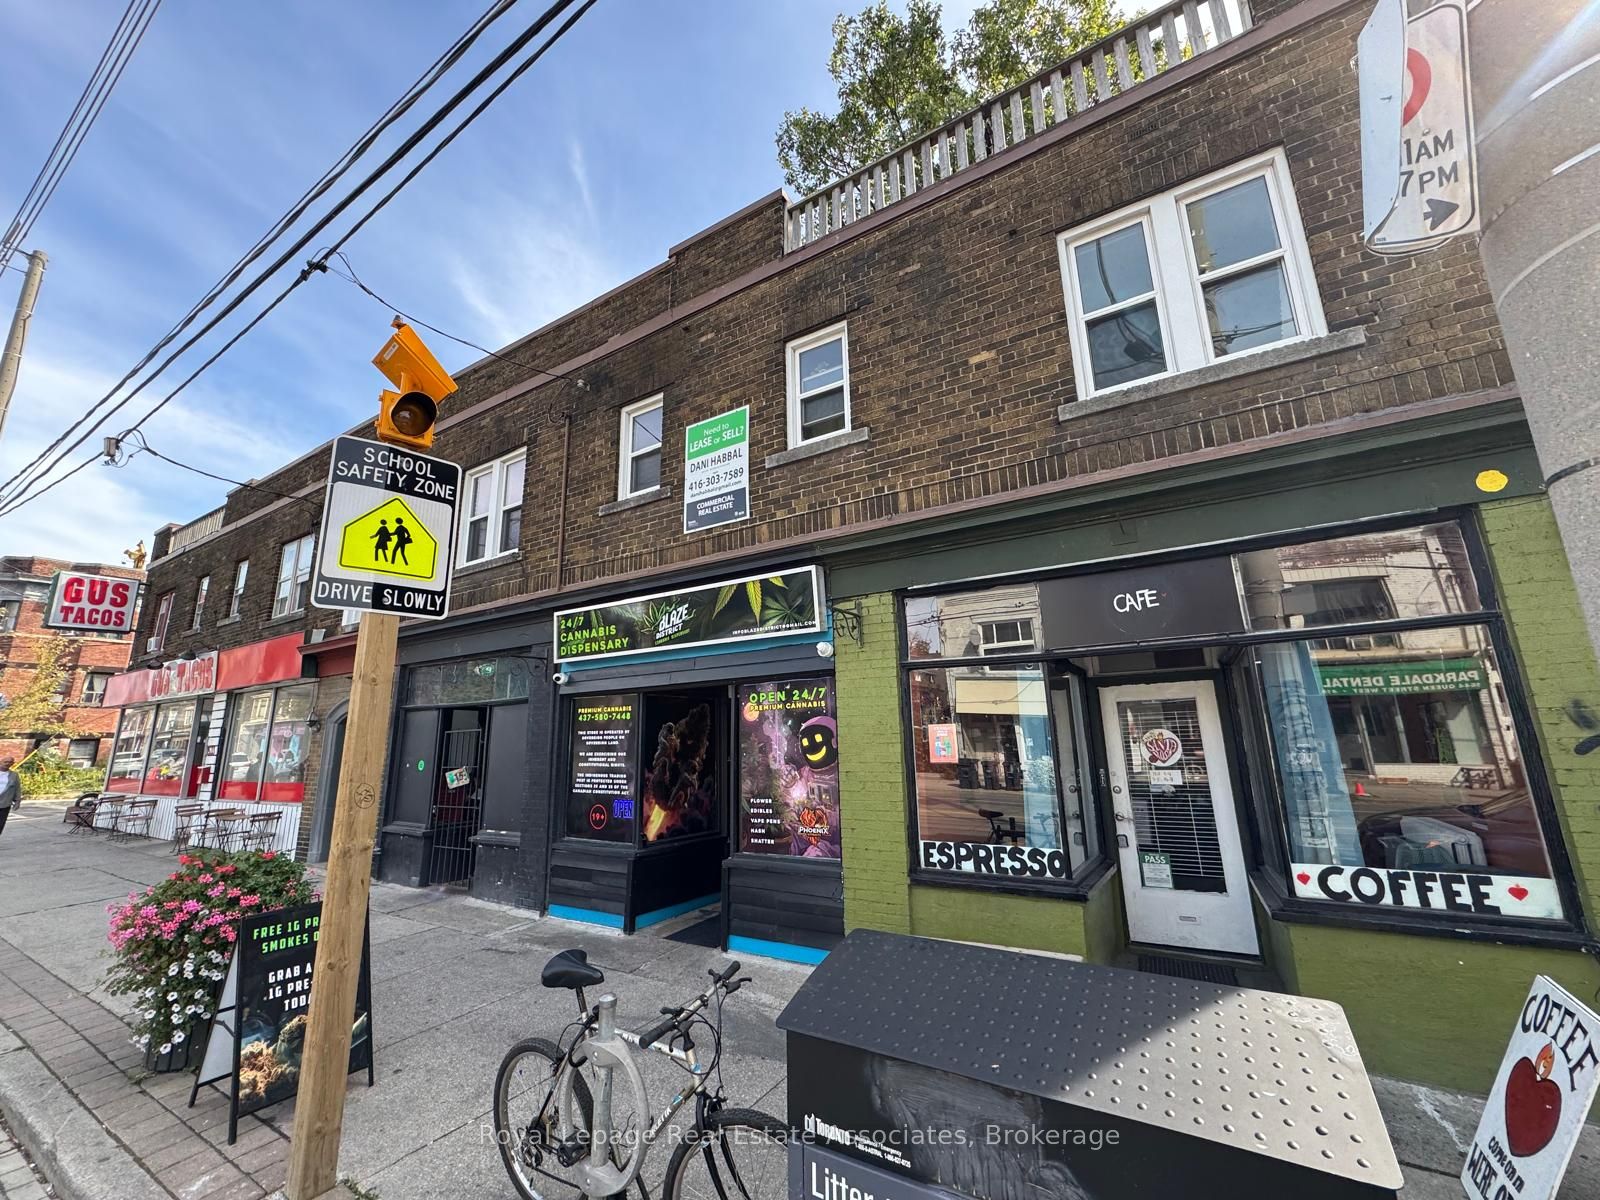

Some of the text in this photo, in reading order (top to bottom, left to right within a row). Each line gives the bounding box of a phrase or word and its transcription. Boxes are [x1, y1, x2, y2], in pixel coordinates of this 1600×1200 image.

[1400, 129, 1454, 166] 1AM
[1400, 160, 1459, 198] 7PM
[690, 437, 712, 452] LEASE
[722, 426, 744, 441] SELL?
[704, 424, 720, 436] Need
[363, 448, 436, 478] SCHOOL
[690, 460, 708, 472] DANI
[710, 448, 742, 466] HABBAL
[336, 461, 454, 500] SAFETY ZONE
[689, 467, 744, 491] 416-303-7589
[696, 494, 735, 510] COMMERCIAL
[698, 502, 734, 517] REAL ESTATE
[64, 577, 130, 608] GUS
[318, 582, 444, 612] DRIVE SLOWLY
[1114, 588, 1160, 612] CAFE
[60, 606, 126, 626] TACOS
[560, 616, 584, 628] 24/7
[658, 604, 689, 632] BLAZE
[560, 625, 616, 642] CANNABIS
[656, 622, 684, 640] DISTRICT
[560, 637, 628, 656] DISPENSARY
[176, 656, 214, 692] TACOS
[750, 687, 826, 703] OPEN 24/7
[786, 701, 826, 709] CANNABIS
[592, 813, 605, 821] 19+
[613, 800, 634, 818] OPEN
[924, 842, 1066, 878] ESPRESSO
[1144, 855, 1166, 864] PASS
[1317, 866, 1500, 912] COFFEE
[253, 916, 319, 940] FREE 1G PR
[262, 931, 320, 954] SMOKES O
[268, 962, 312, 984] GRAB A
[268, 978, 313, 1000] 1G PRE-
[1521, 993, 1599, 1092] COFFEE
[816, 1118, 850, 1146] TORONTO
